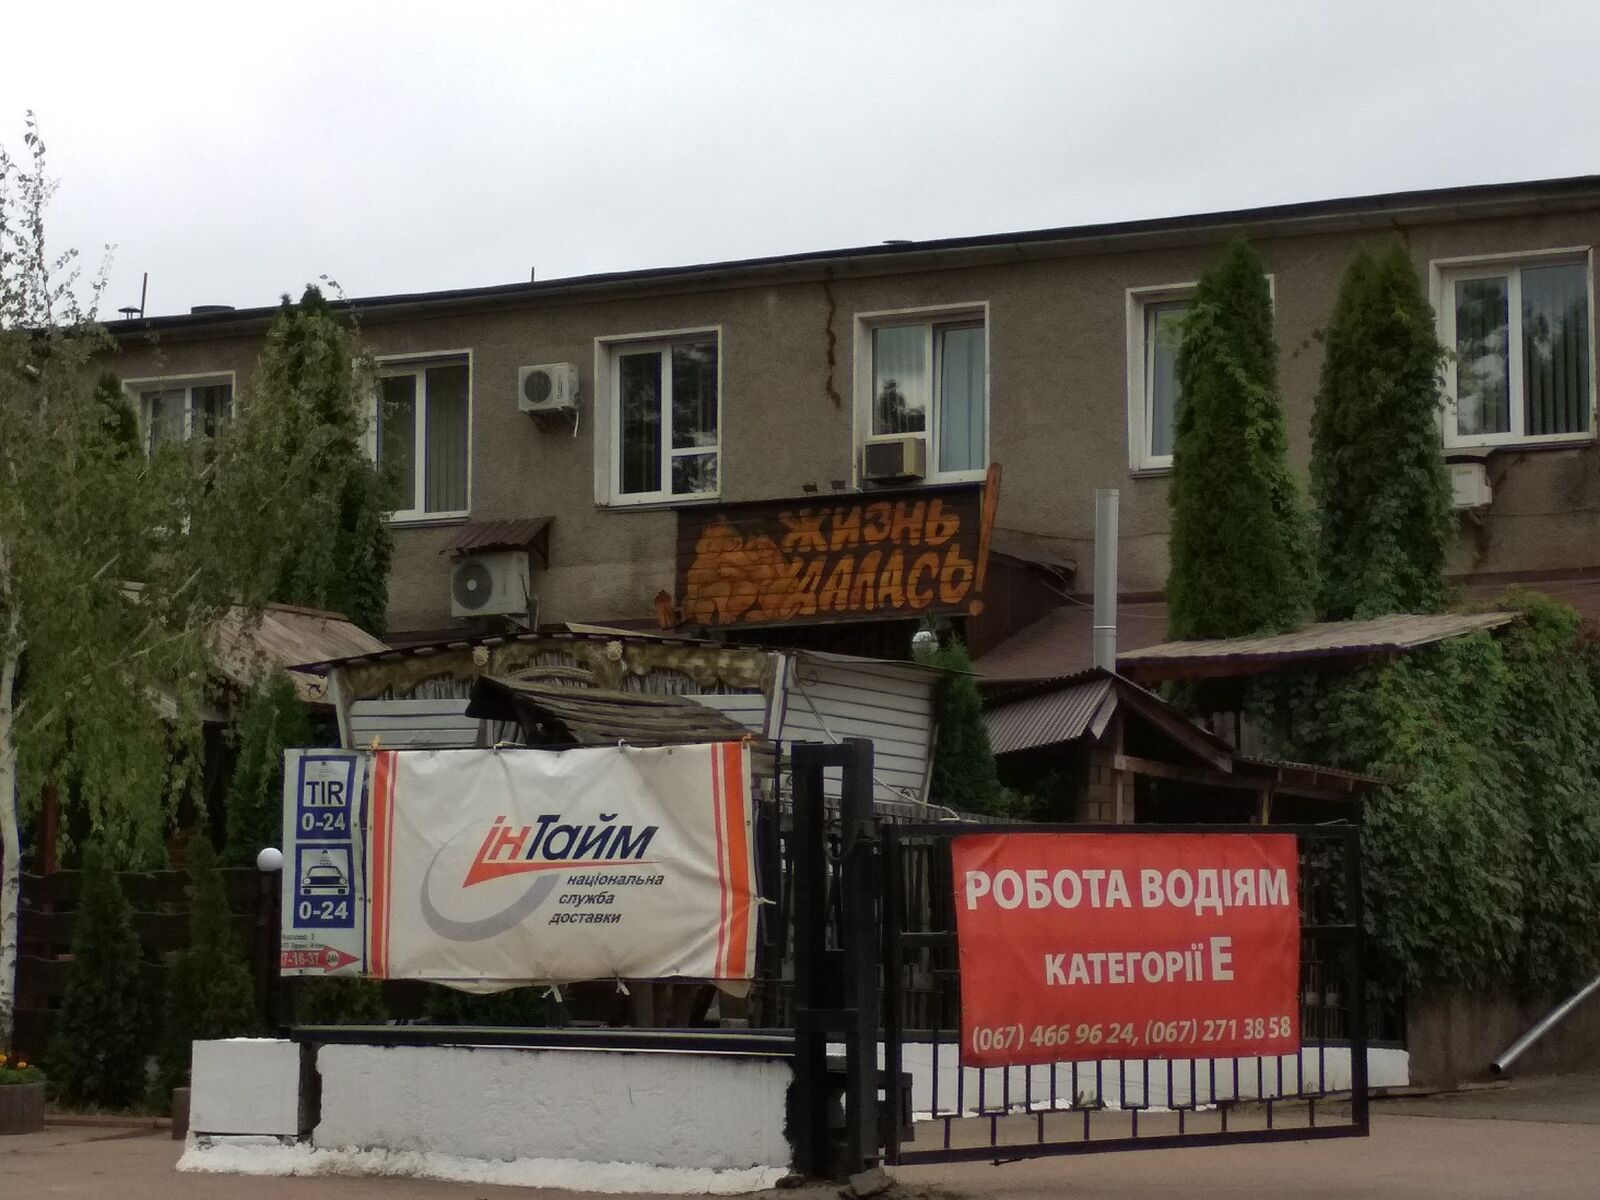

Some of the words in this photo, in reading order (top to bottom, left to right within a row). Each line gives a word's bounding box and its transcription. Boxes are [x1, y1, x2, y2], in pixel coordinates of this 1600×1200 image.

[779, 499, 960, 552] ЖИЗНЬ
[305, 780, 344, 805] TIR
[301, 812, 346, 831] 0-24
[566, 872, 665, 887] національна
[559, 892, 615, 908] служба
[965, 868, 1132, 910] РОБОТА
[1141, 868, 1289, 916] ВОДІЯМ
[299, 901, 348, 920] 0-24
[548, 911, 622, 926] доставки
[1045, 943, 1204, 985] КАТЕГОРІЇ
[1210, 936, 1234, 981] Е
[972, 1024, 1024, 1054] (067)
[1030, 1024, 1070, 1047] 466
[1075, 1023, 1102, 1045] 96
[1106, 1022, 1138, 1046] 24,
[1145, 1018, 1197, 1045] (067)
[1202, 1019, 1237, 1042] 271
[1243, 1017, 1264, 1040] 38
[1269, 1016, 1291, 1039] 58
